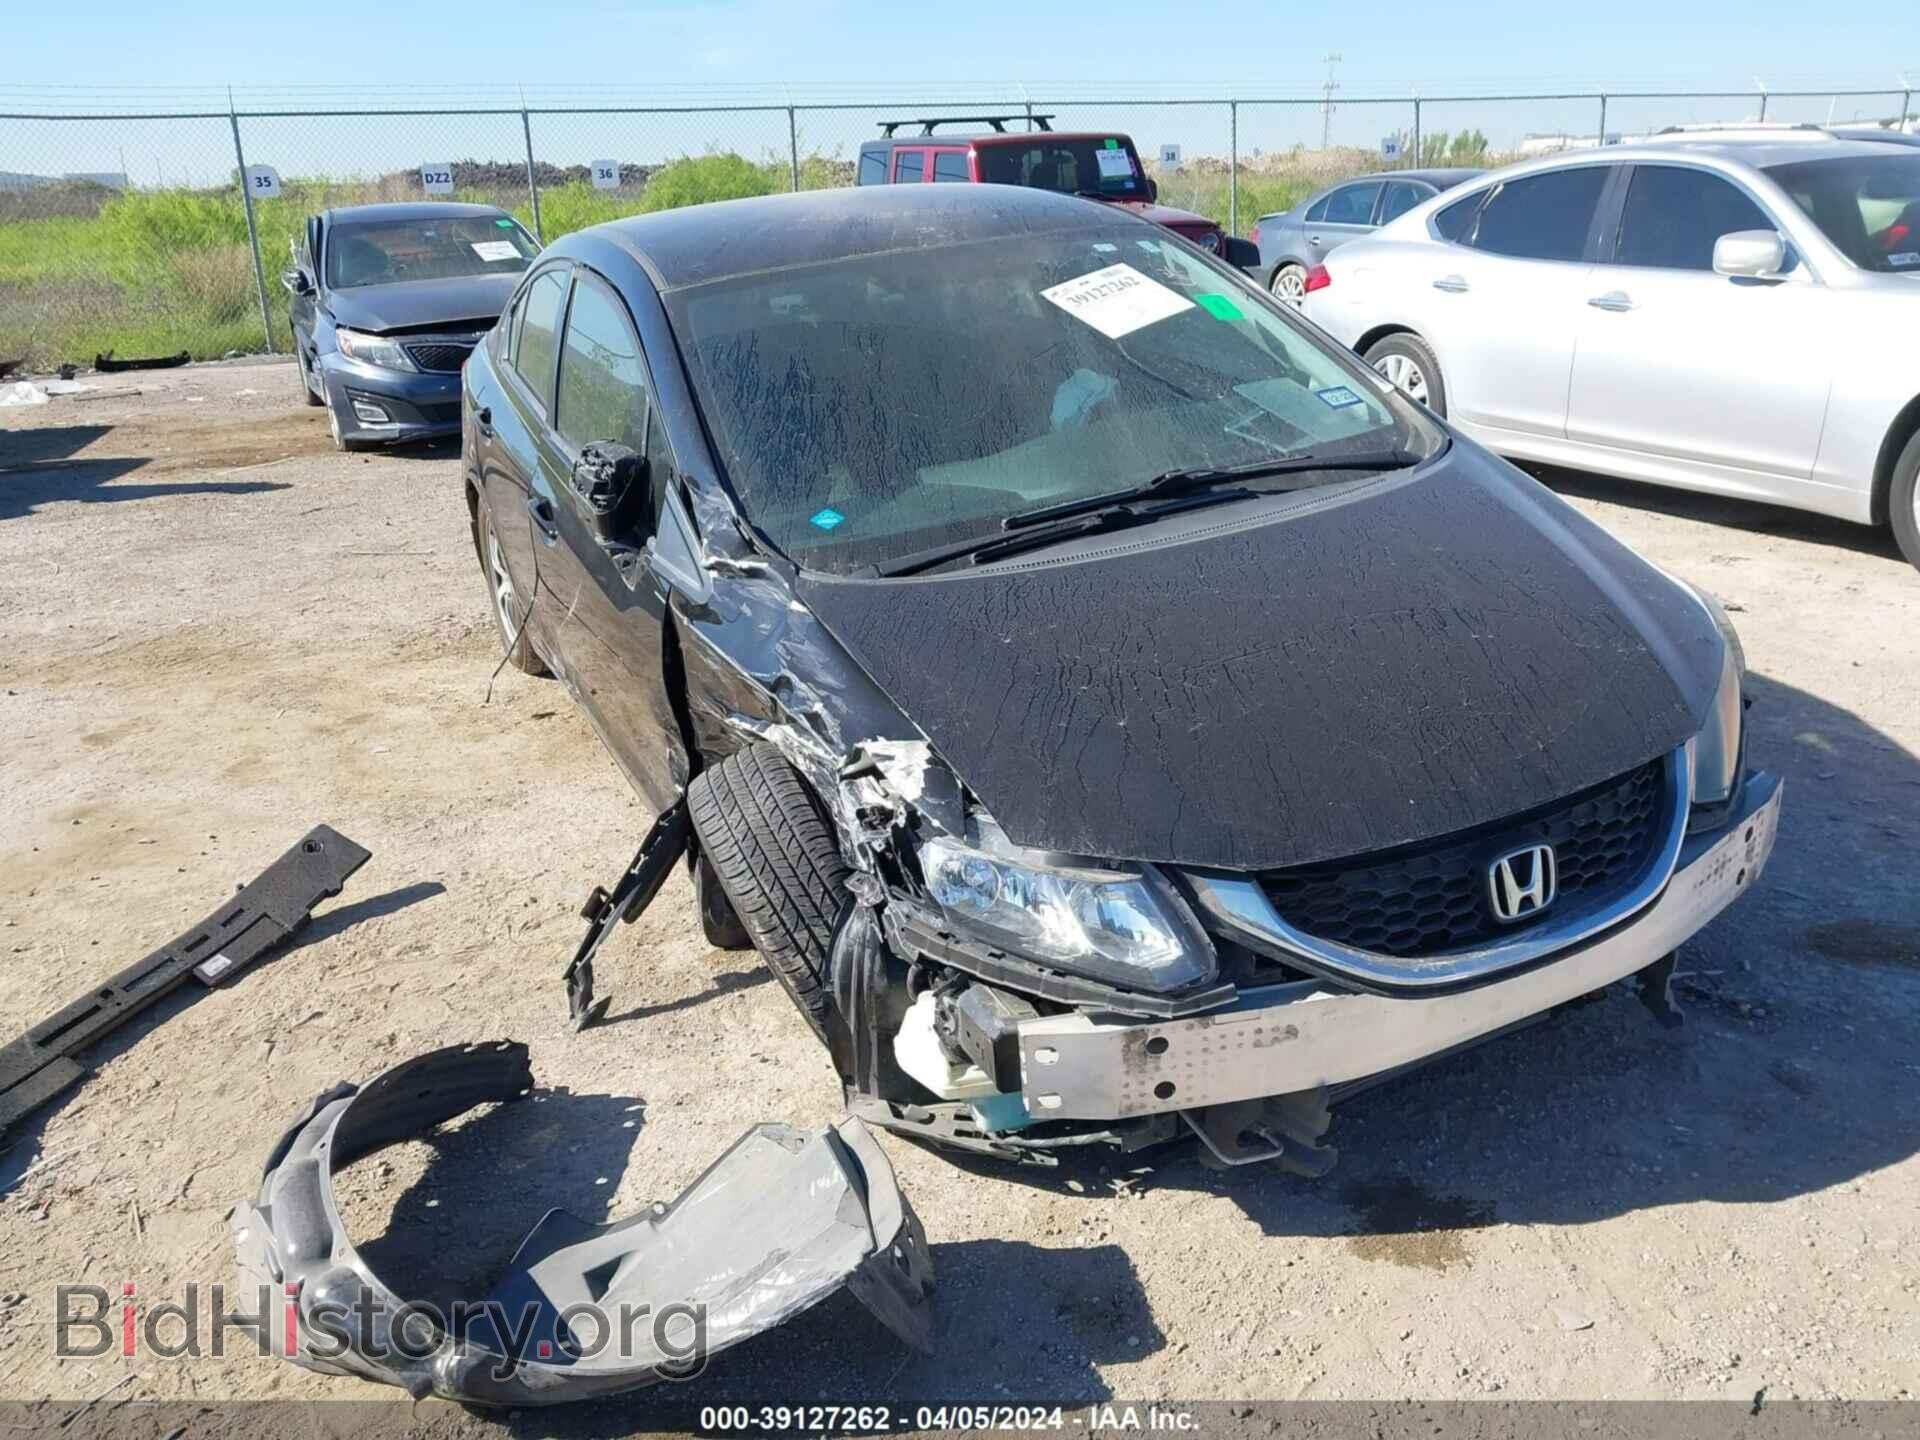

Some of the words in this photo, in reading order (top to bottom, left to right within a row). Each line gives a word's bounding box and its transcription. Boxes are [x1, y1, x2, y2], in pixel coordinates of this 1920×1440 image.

[425, 172, 451, 184] DZ2
[599, 168, 613, 179] 36
[255, 176, 272, 188] 35
[1066, 275, 1141, 306] 39127262
